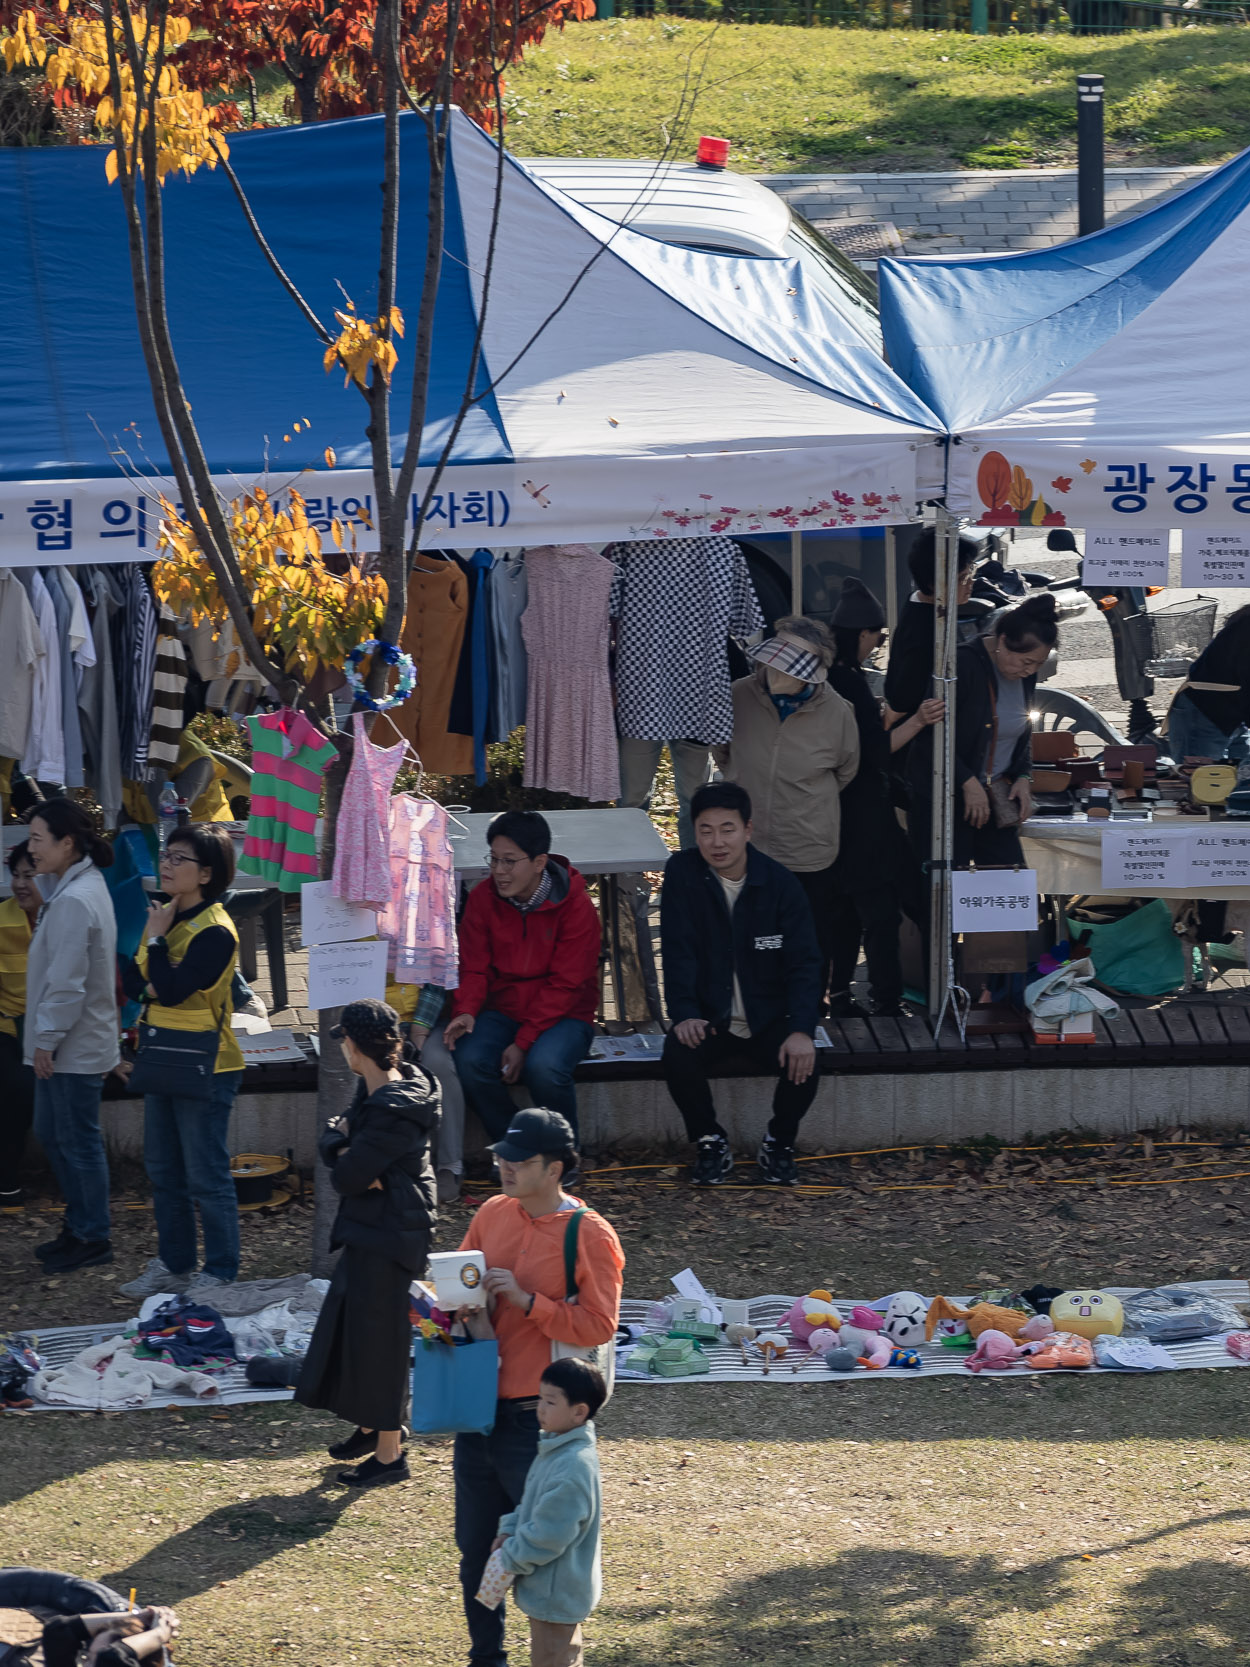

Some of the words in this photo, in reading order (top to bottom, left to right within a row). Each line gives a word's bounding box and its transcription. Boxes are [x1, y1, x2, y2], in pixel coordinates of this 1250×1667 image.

[1094, 537, 1114, 545] ALL
[1196, 838, 1217, 846] ALL
[959, 895, 1031, 909] 아워가죽공방
